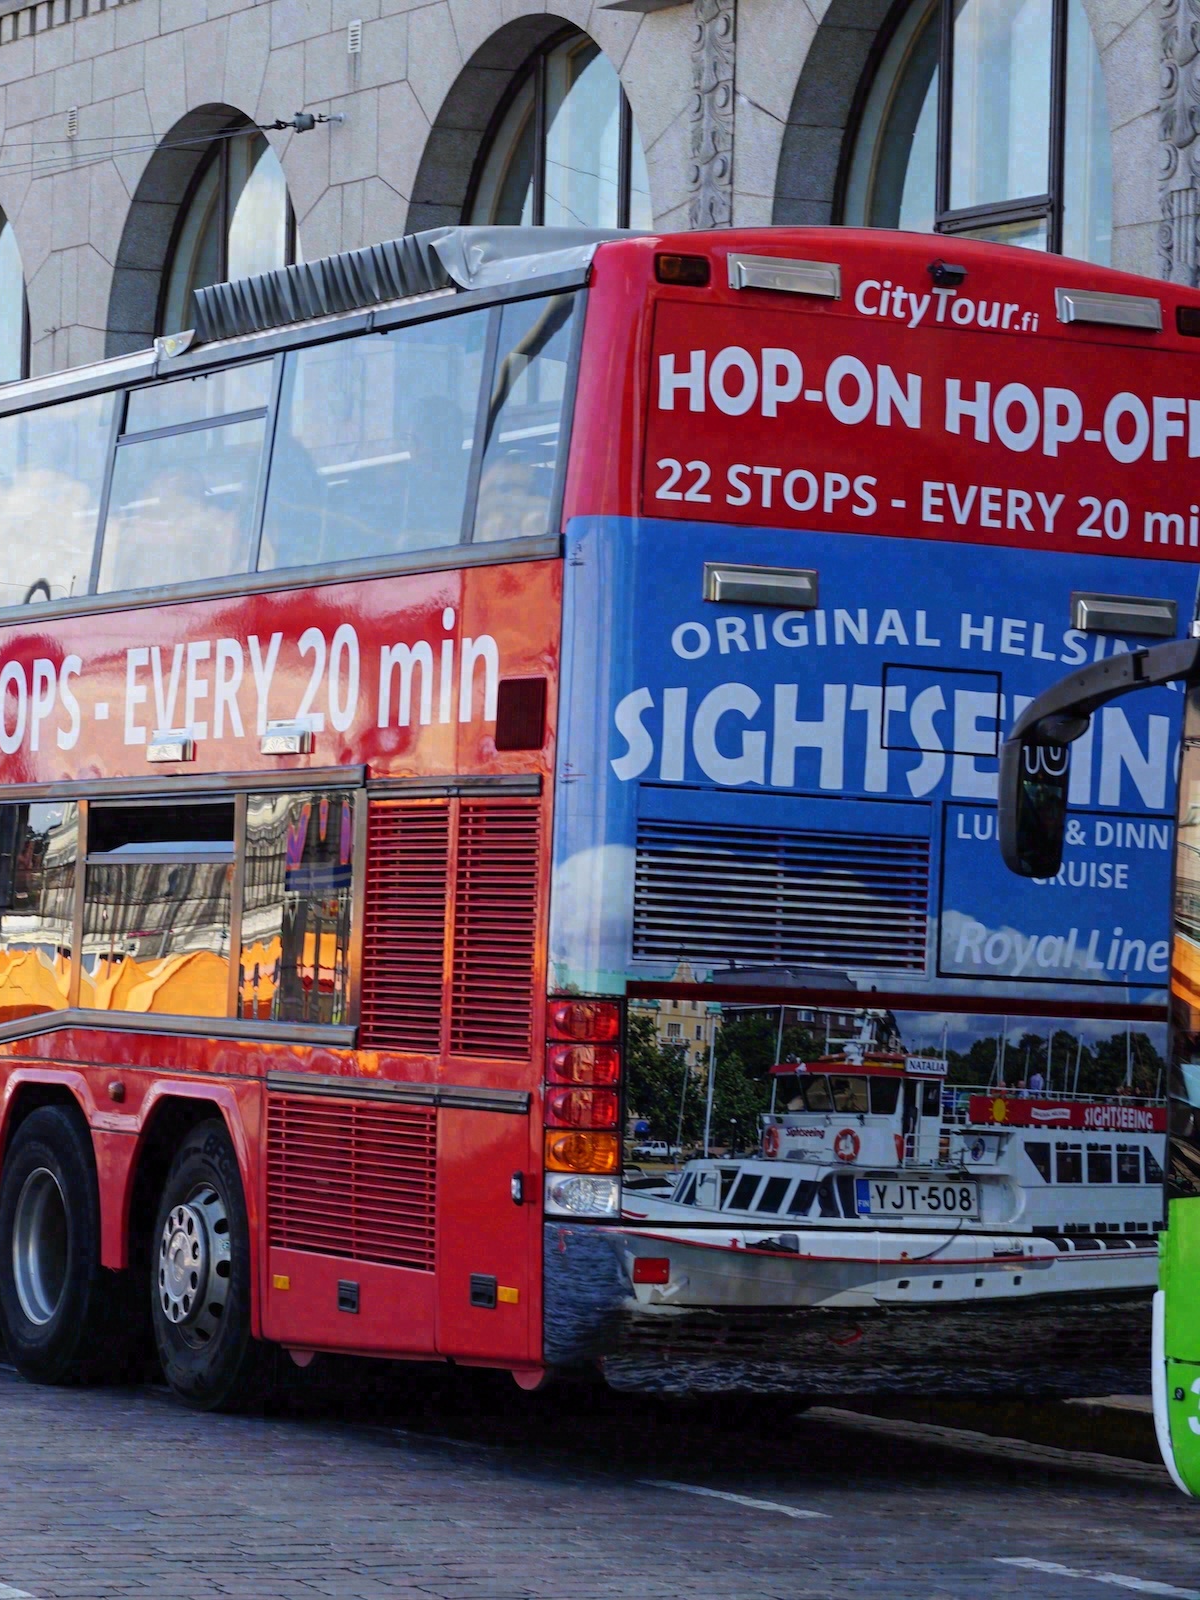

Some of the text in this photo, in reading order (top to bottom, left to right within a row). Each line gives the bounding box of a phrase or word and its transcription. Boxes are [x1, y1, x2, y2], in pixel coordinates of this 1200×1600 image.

[854, 280, 1038, 332] CityTour.fi
[658, 346, 922, 429] HOP-ON
[655, 458, 712, 502] 22
[726, 464, 877, 517] STOPS
[921, 481, 1065, 533] EVERY
[1077, 496, 1129, 539] 20
[1144, 504, 1200, 547] mi
[671, 608, 941, 660] ORIGINAL
[124, 632, 284, 745] EVERY
[297, 623, 360, 733] 20
[378, 607, 498, 728] min
[1065, 819, 1173, 851] & DINN
[954, 921, 1169, 977] Royal Line
[908, 1060, 946, 1073] NATALIA
[1085, 1107, 1153, 1129] SIGHTSEEING
[875, 1184, 972, 1211] YJT-508
